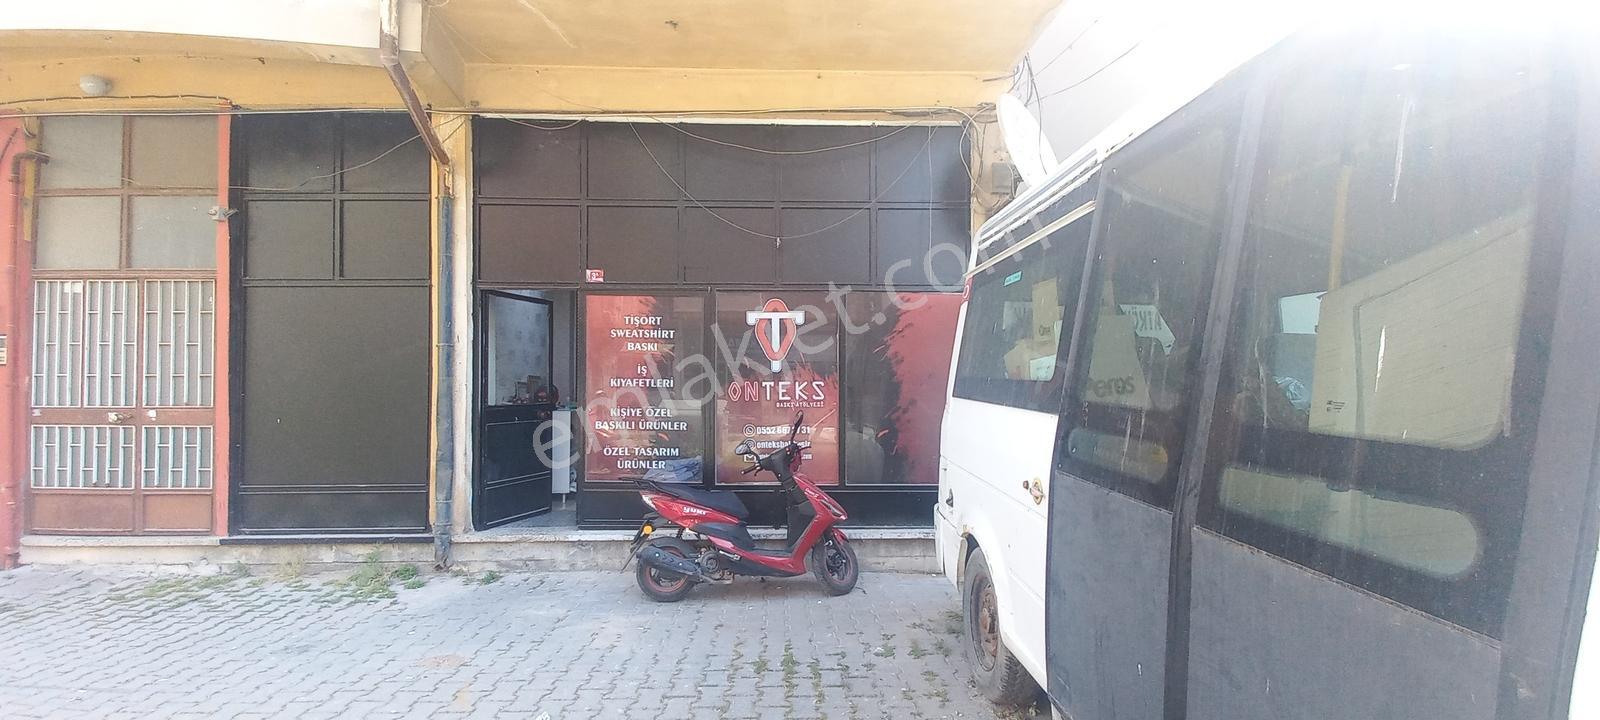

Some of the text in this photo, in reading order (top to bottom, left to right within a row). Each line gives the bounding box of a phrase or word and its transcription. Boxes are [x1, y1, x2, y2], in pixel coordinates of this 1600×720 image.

[610, 328, 676, 339] SWEATSHİRT
[627, 342, 658, 351] BASKI
[637, 363, 648, 377] İŞ
[610, 377, 674, 388] KIYAFETLERİ
[728, 381, 825, 402] ONTEKS
[610, 406, 642, 419] KİŞİYE
[595, 419, 688, 431] BASKILI ÜRÜNLER
[603, 445, 679, 457] ÖZEL TASARIM
[617, 459, 666, 469] ÜRÜNLER
